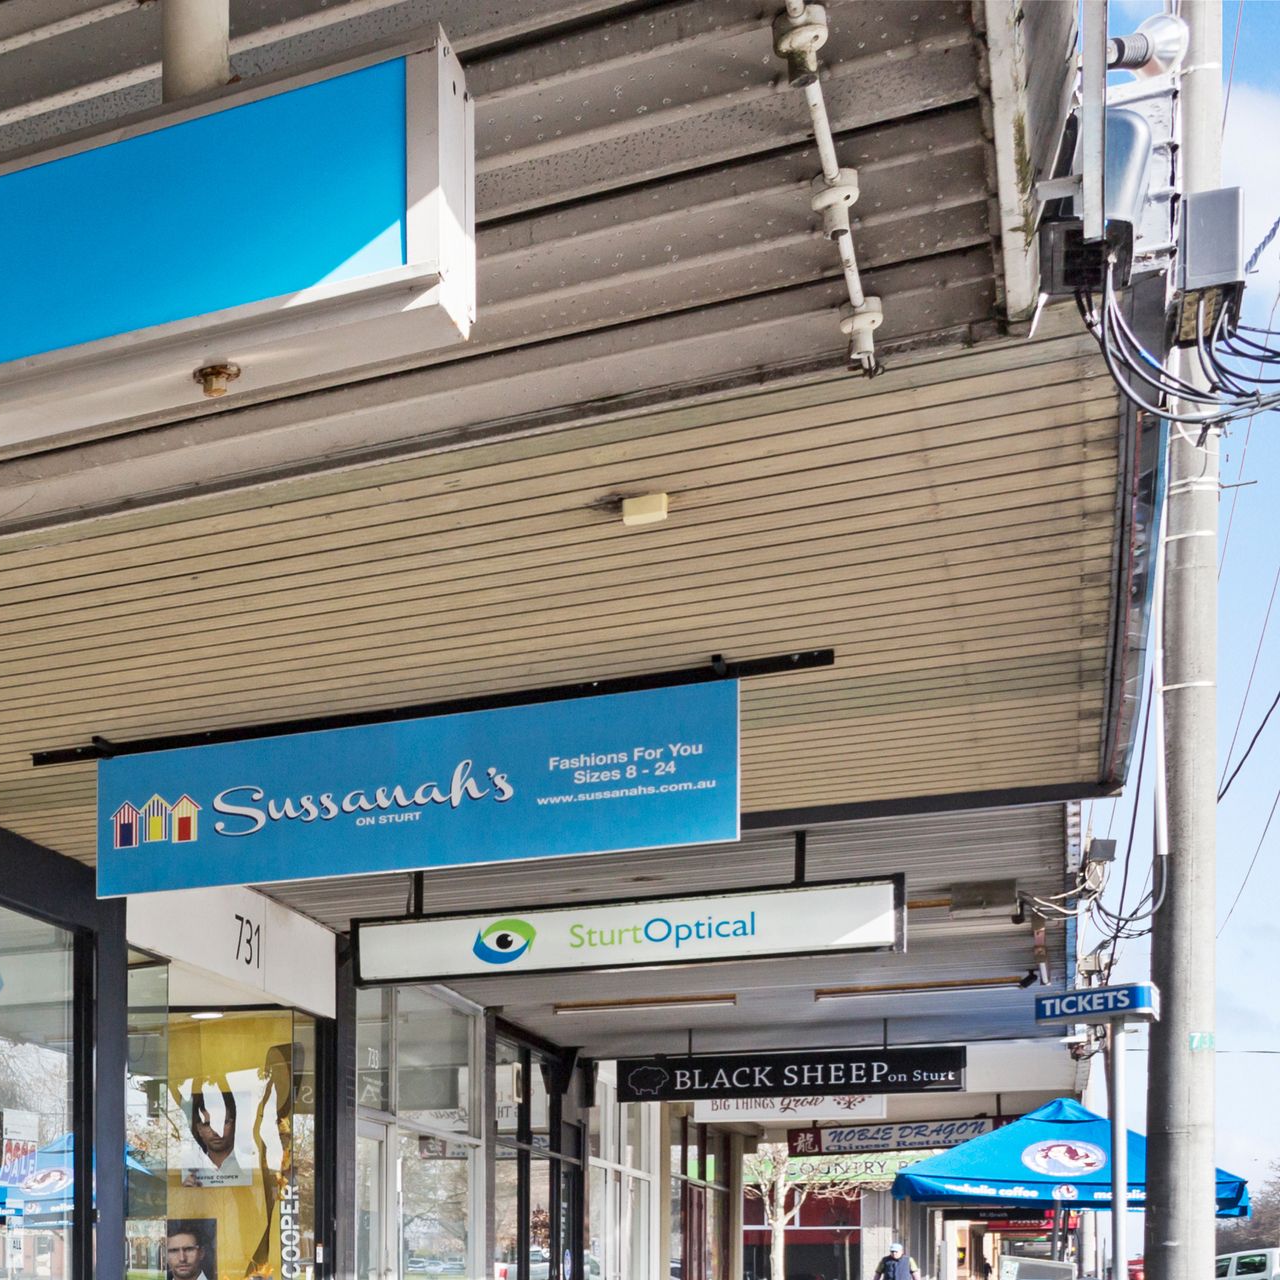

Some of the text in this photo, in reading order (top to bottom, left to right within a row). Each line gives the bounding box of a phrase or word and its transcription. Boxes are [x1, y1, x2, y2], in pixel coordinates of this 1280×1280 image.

[548, 743, 703, 771] Fashions For You
[573, 769, 621, 784] Sizes
[625, 765, 637, 778] 8
[654, 761, 676, 776] 24
[212, 759, 515, 836] Sussanah's
[537, 779, 716, 805] www.sussanahs.com.au
[356, 811, 422, 827] ON STURT
[234, 913, 261, 969] 731
[1042, 989, 1130, 1017] TICKETS
[674, 1062, 956, 1091] BLACK SHEEP on Sturt
[711, 1098, 731, 1111] BIG
[735, 1097, 776, 1111] THINGS
[825, 1136, 971, 1153] Chinese Restaura
[828, 1120, 986, 1143] NOBLE DRAGON
[281, 1184, 301, 1279] COOPER
